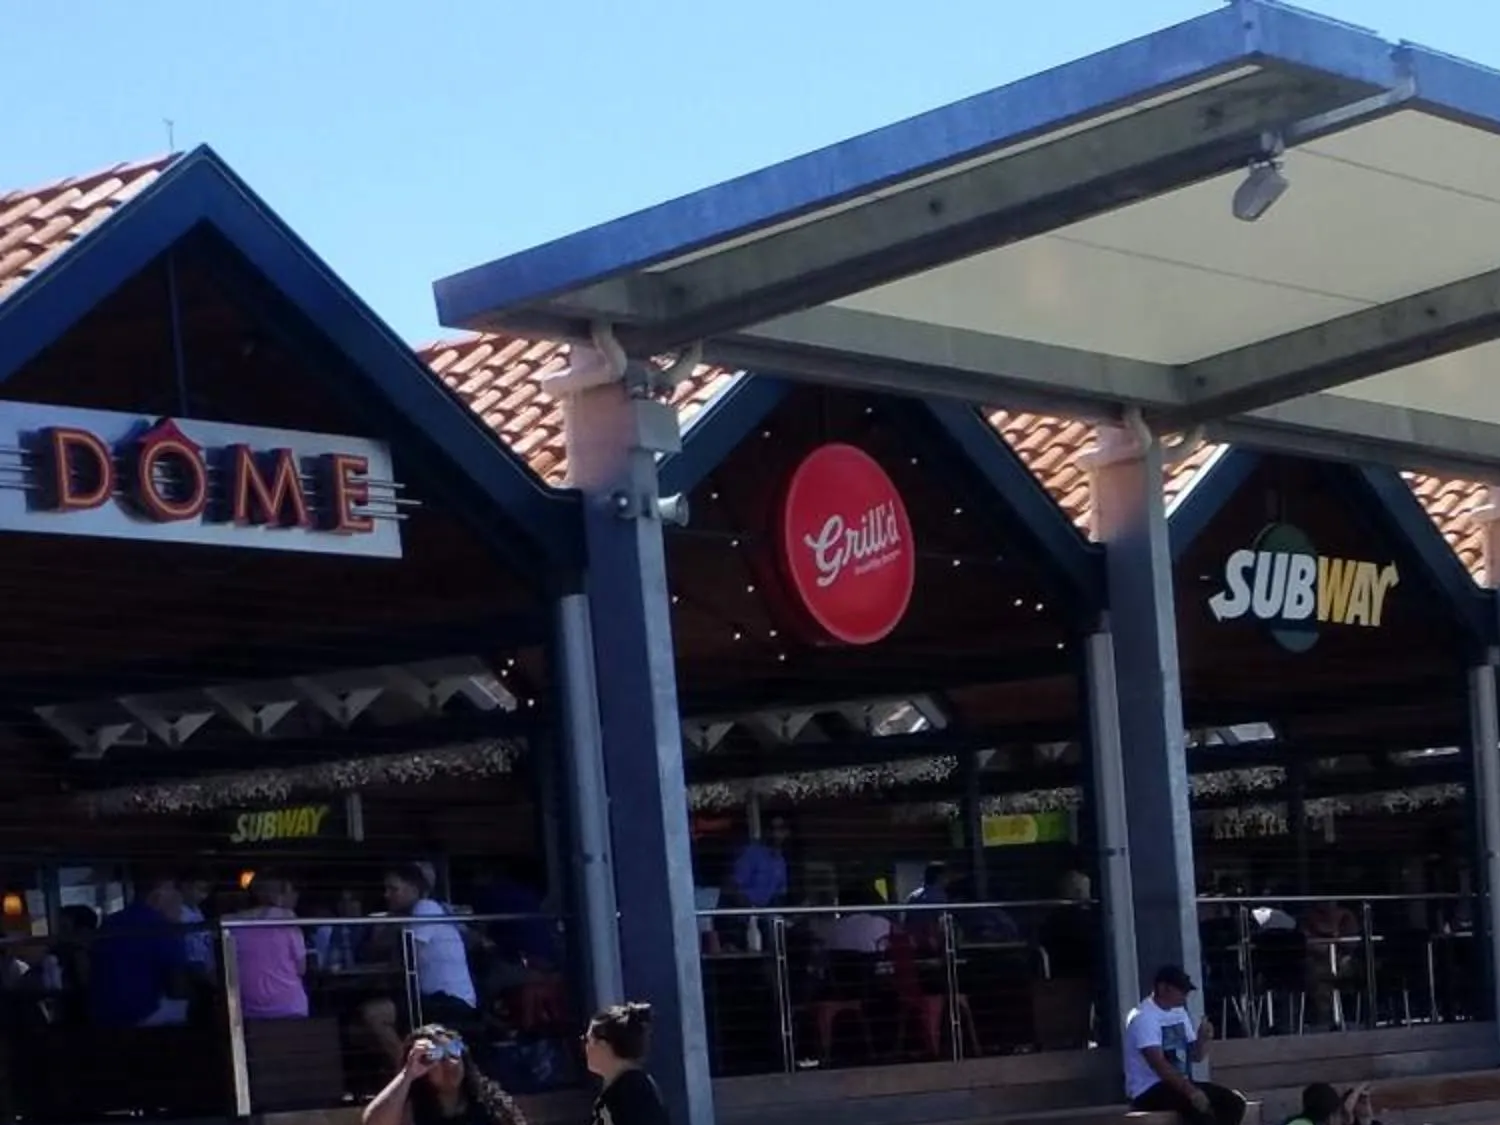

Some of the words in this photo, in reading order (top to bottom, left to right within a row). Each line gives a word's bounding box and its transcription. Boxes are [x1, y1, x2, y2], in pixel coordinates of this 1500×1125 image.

[804, 499, 901, 587] Grill'd
[1208, 549, 1400, 627] SUBWAY
[230, 804, 330, 843] SUBWAY
